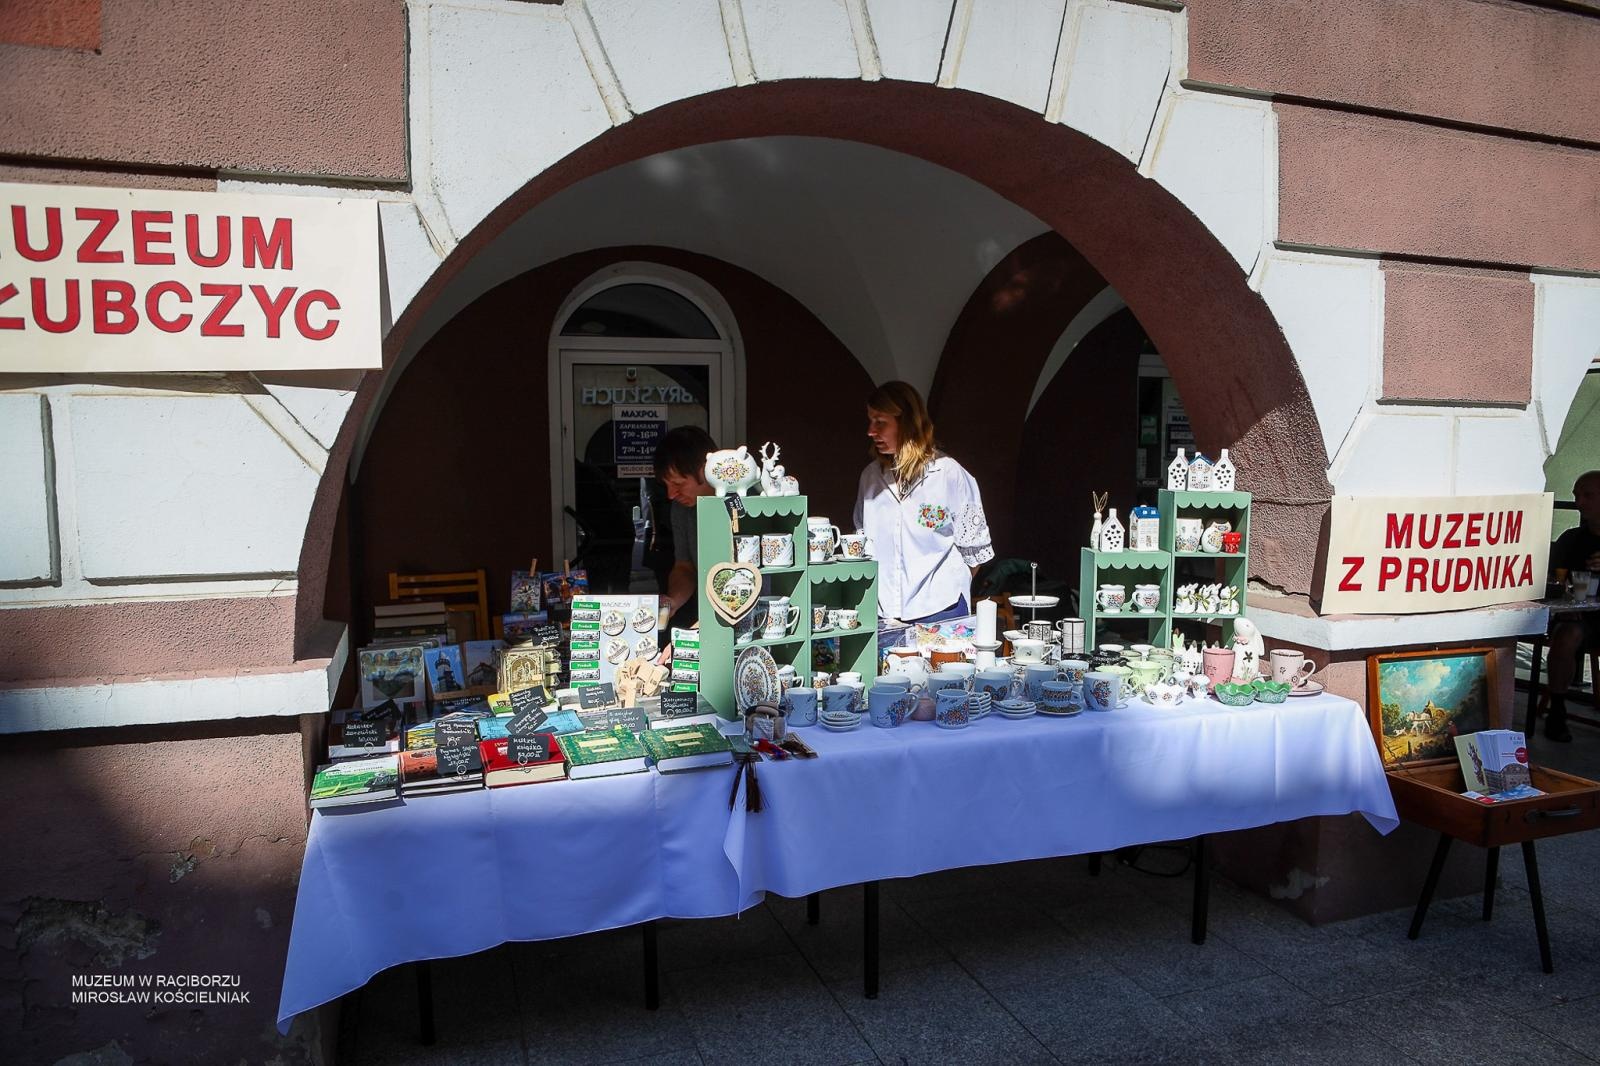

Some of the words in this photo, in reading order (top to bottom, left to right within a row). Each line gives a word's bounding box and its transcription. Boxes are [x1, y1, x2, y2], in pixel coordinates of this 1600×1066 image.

[0, 204, 293, 271] UZEUM
[621, 410, 659, 418] MAXPOL
[1385, 510, 1523, 550] MUZEUM
[1338, 557, 1365, 592] Z
[1377, 554, 1535, 594] PRUDNIKA
